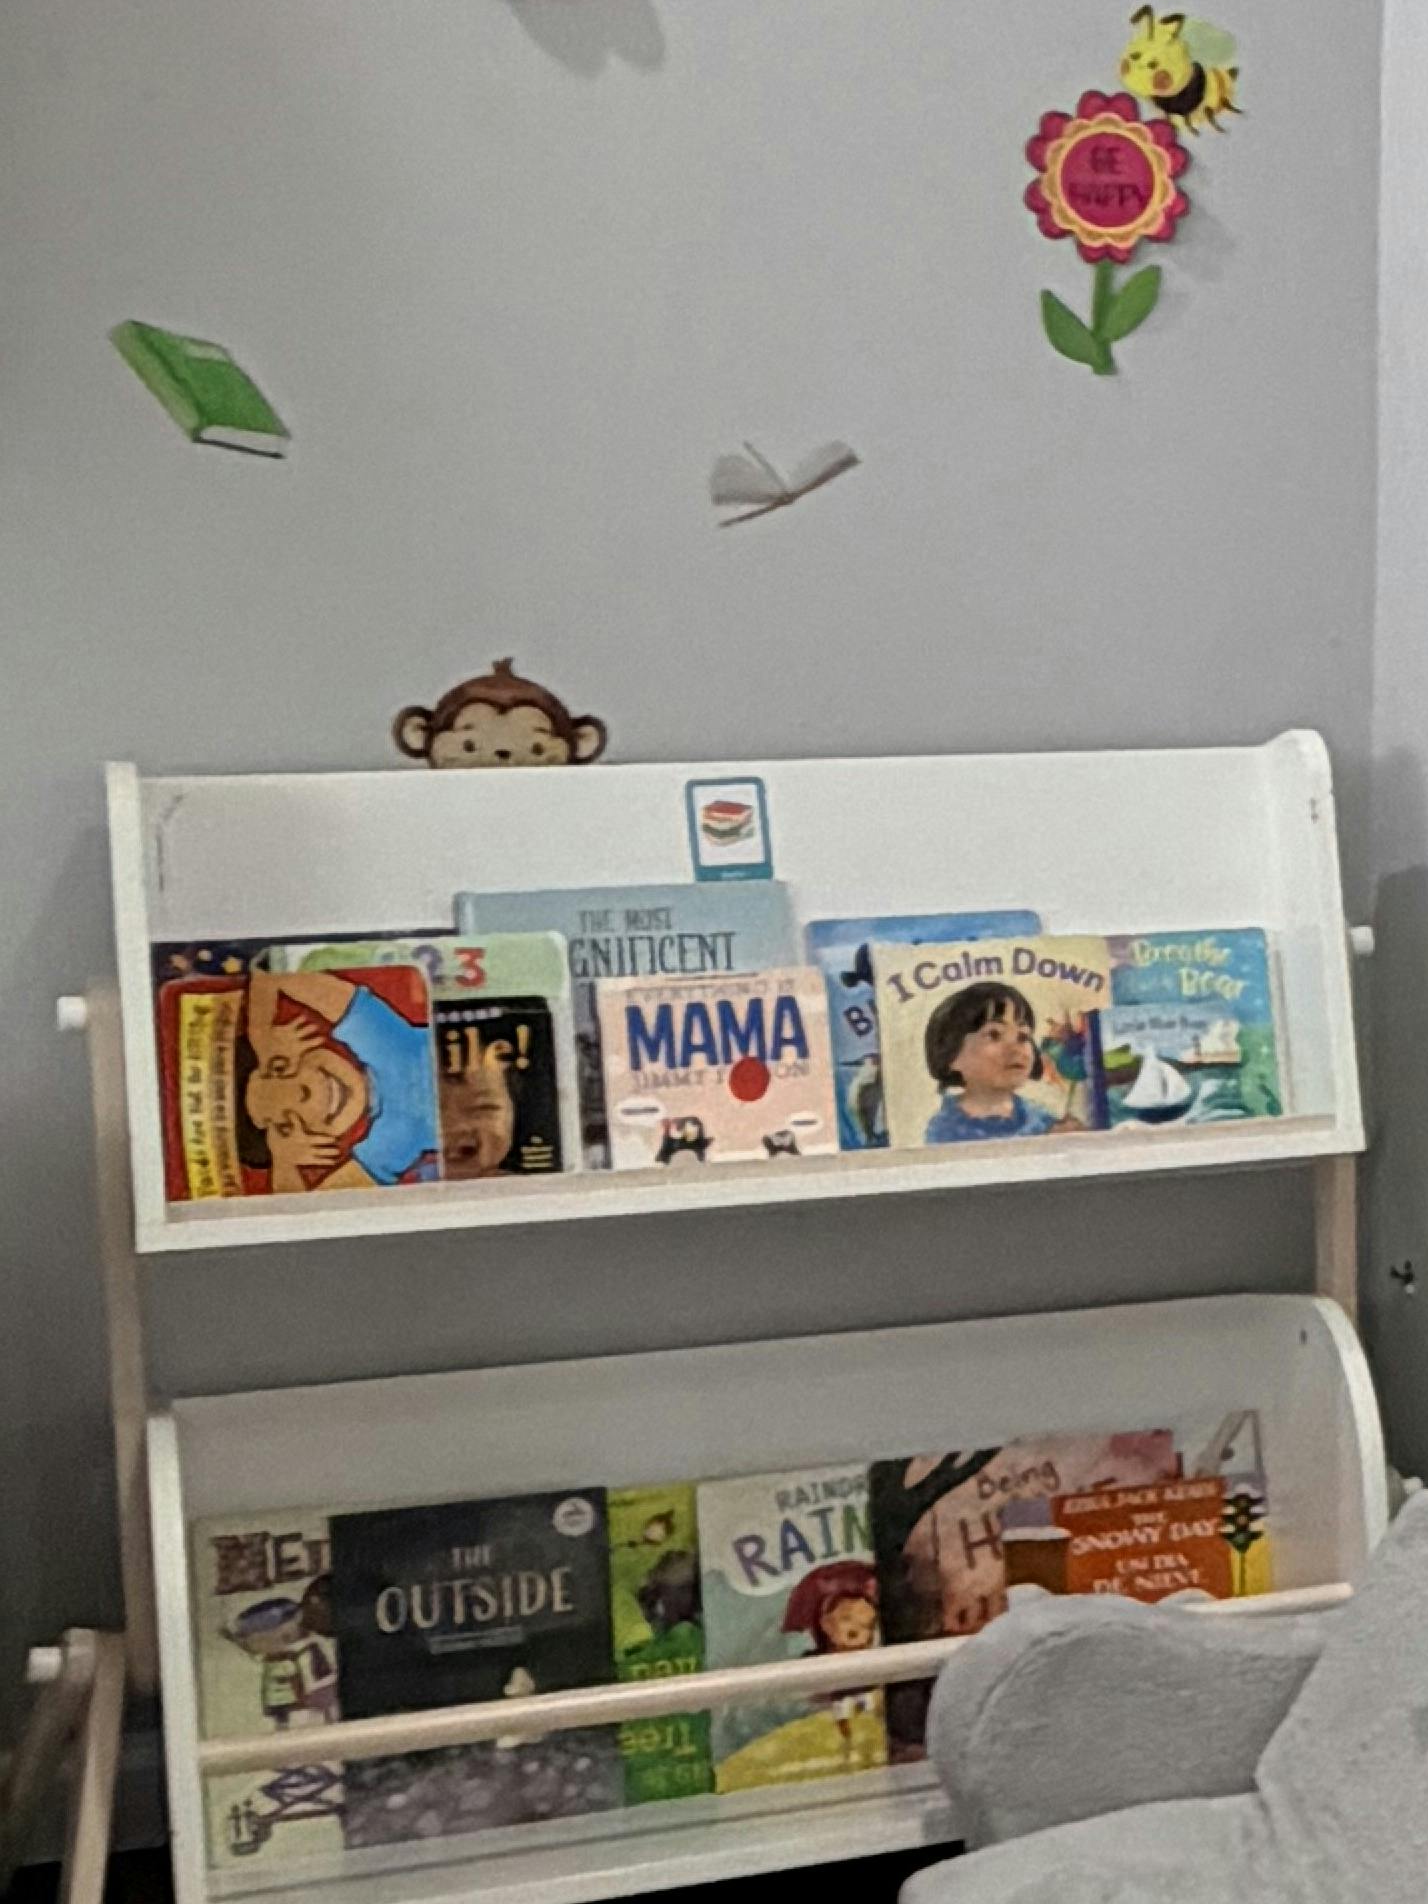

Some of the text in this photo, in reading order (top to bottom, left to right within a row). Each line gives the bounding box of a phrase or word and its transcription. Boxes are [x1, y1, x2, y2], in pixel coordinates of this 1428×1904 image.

[453, 946, 487, 988] 3
[885, 973, 913, 1005] I
[912, 951, 1004, 994] Calm
[1012, 946, 1106, 995] Down
[624, 995, 810, 1072] MAMA
[451, 1543, 492, 1568] THE
[1070, 1517, 1220, 1556] SNOWY DAY
[375, 1565, 574, 1635] OUTSIDE
